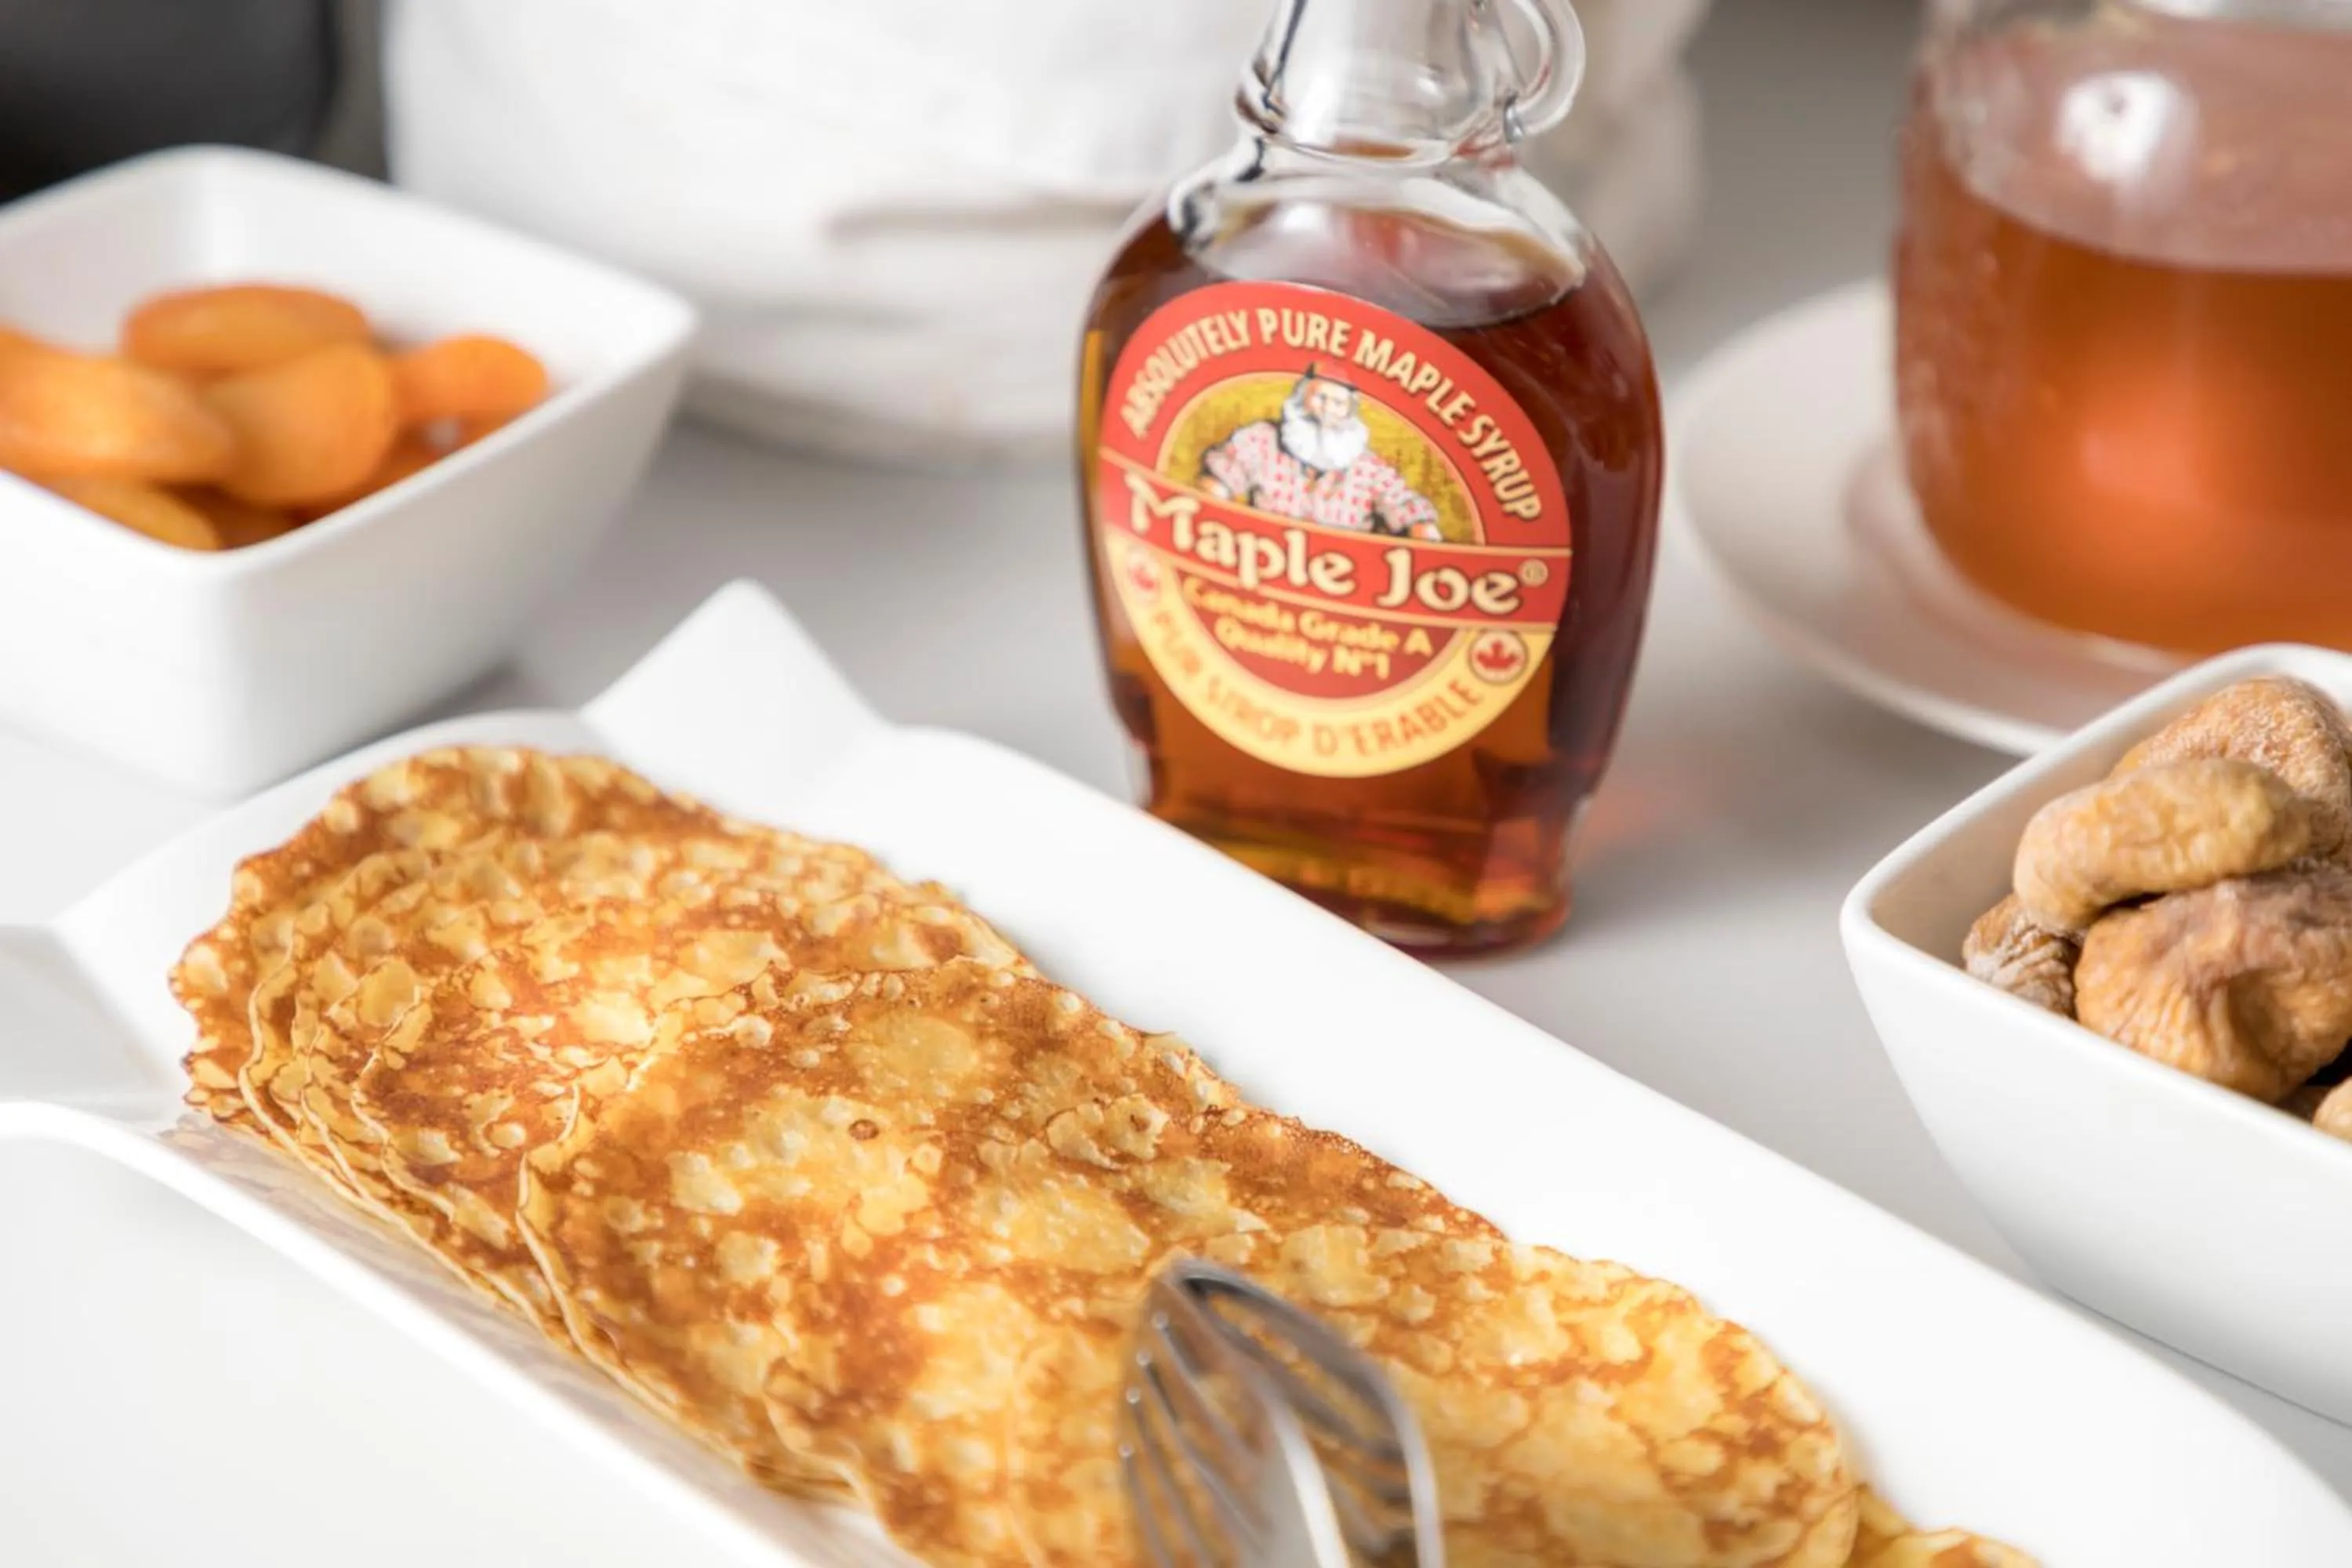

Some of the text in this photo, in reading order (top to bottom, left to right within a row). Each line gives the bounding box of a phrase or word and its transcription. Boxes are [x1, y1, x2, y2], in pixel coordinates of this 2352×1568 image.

[1120, 307, 1541, 519] ABSOLUTELY PURE MAPLE SYRUP
[1124, 473, 1355, 596] Maple
[1183, 576, 1432, 657] Canada Grade A
[1215, 615, 1328, 674] Quality
